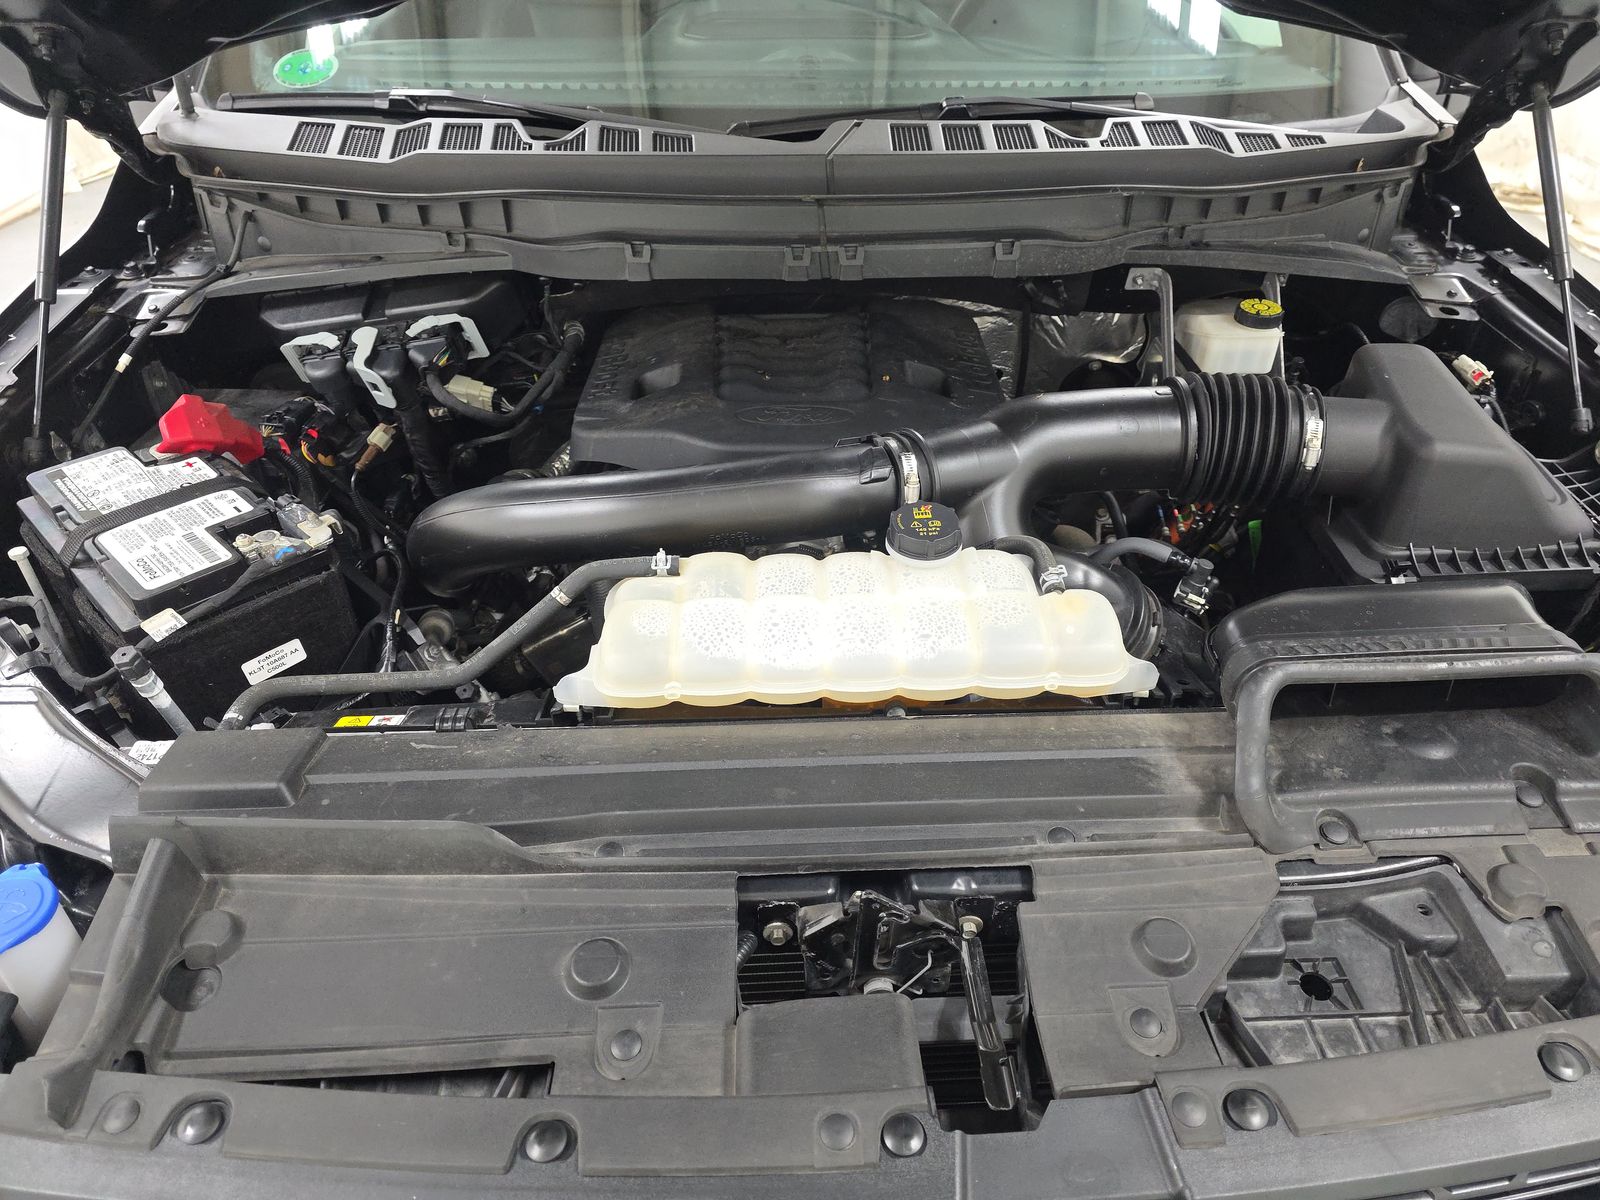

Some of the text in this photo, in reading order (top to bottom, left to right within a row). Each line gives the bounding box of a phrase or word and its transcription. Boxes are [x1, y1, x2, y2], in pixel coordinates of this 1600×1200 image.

[258, 649, 285, 664] FoMoCo
[248, 664, 265, 677] KL3T
[266, 661, 287, 674] C500L
